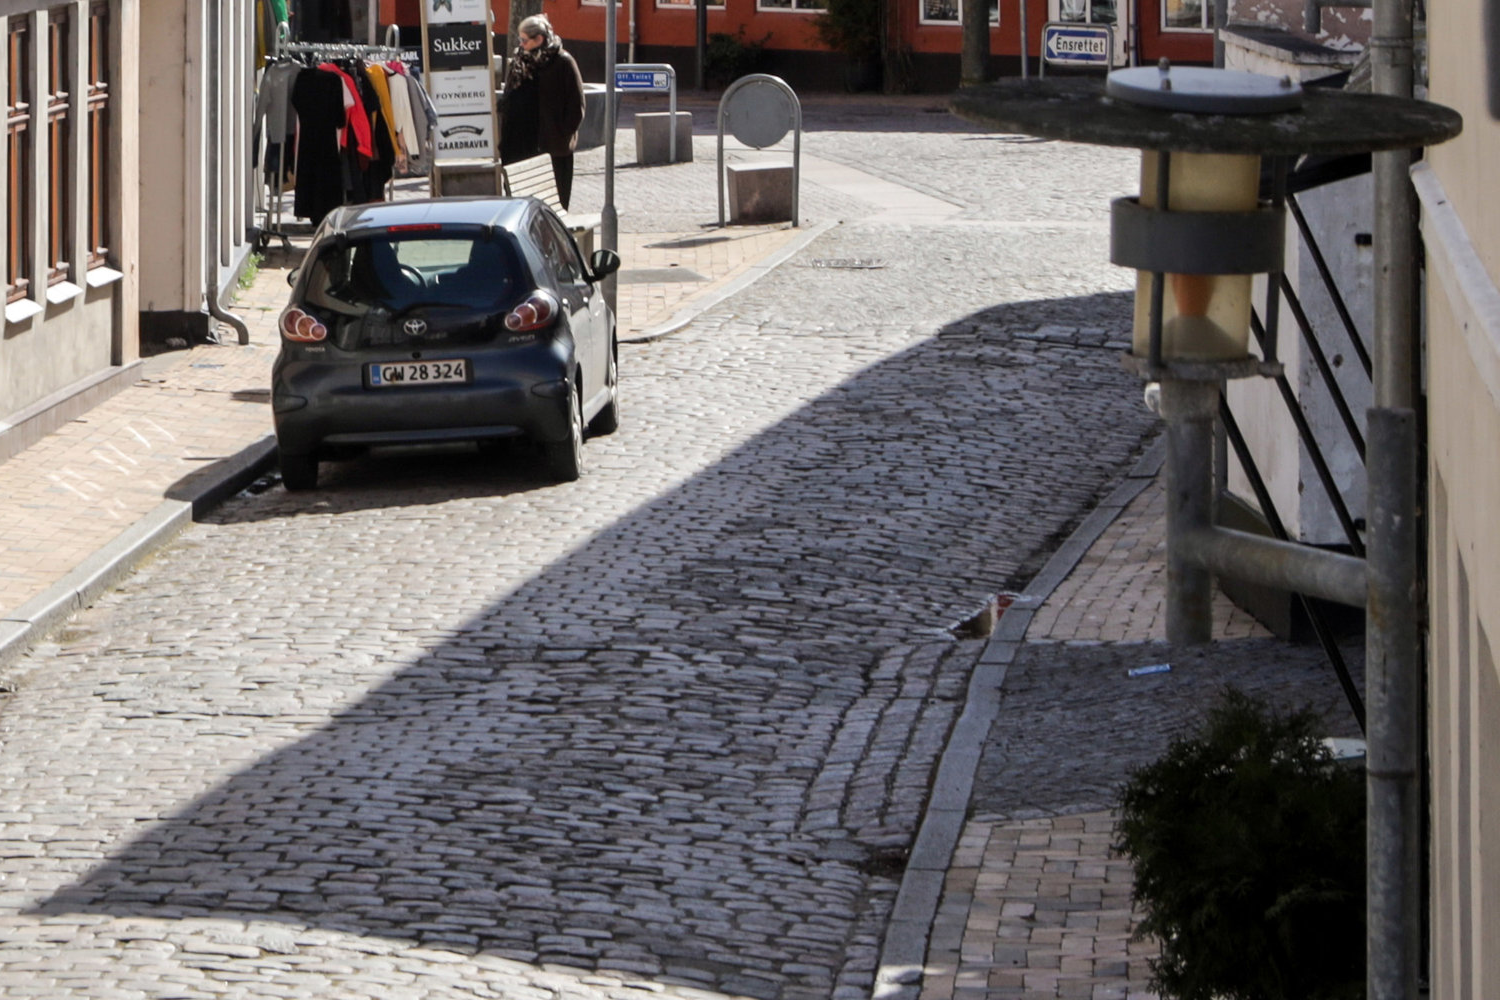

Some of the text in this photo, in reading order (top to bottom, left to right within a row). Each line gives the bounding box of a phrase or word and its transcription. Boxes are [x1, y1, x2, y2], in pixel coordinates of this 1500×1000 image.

[433, 37, 481, 52] Sukker
[1056, 37, 1104, 53] Ensrettet
[436, 91, 486, 100] FOYNBERG
[408, 364, 429, 381] 28
[432, 363, 463, 380] 324
